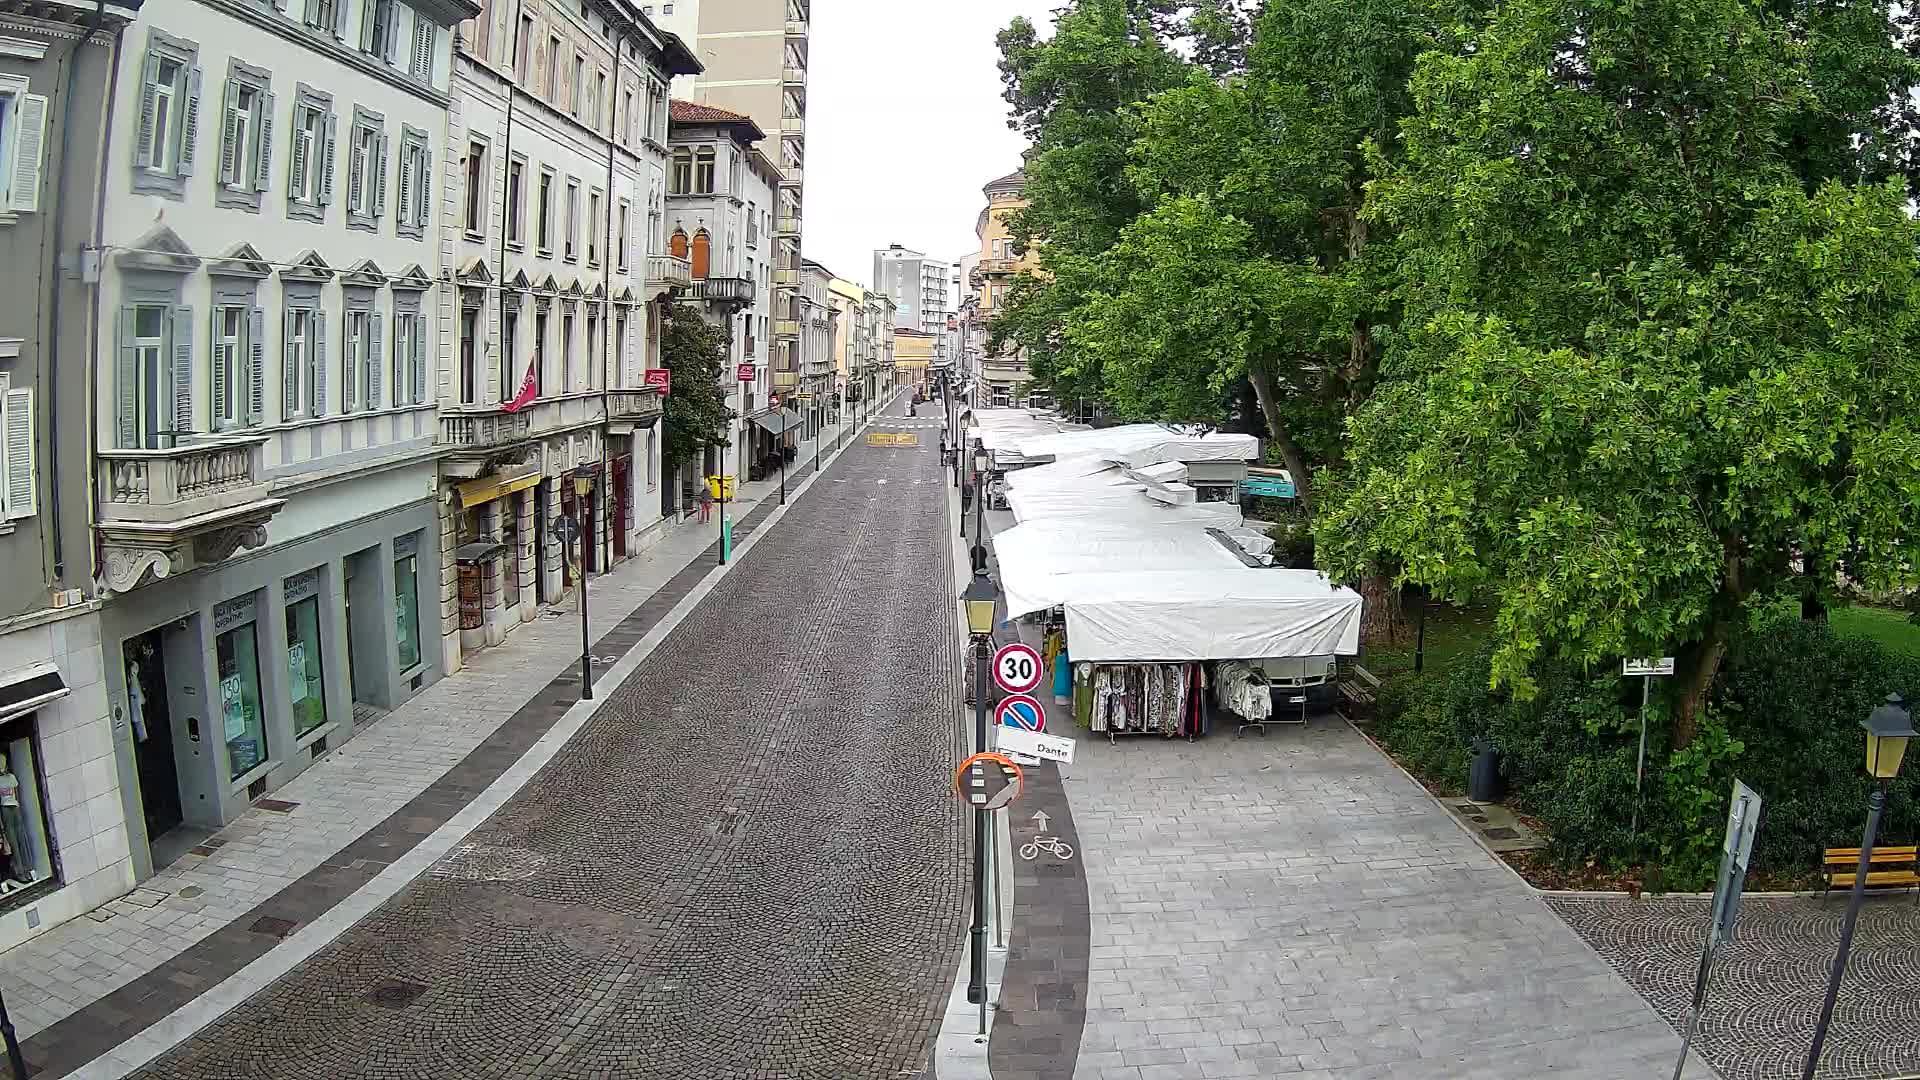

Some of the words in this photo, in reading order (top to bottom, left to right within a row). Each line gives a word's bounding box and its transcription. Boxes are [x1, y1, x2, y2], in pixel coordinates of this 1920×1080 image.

[1005, 657, 1032, 680] 30
[222, 677, 240, 700] 130
[1037, 744, 1067, 757] Dante
